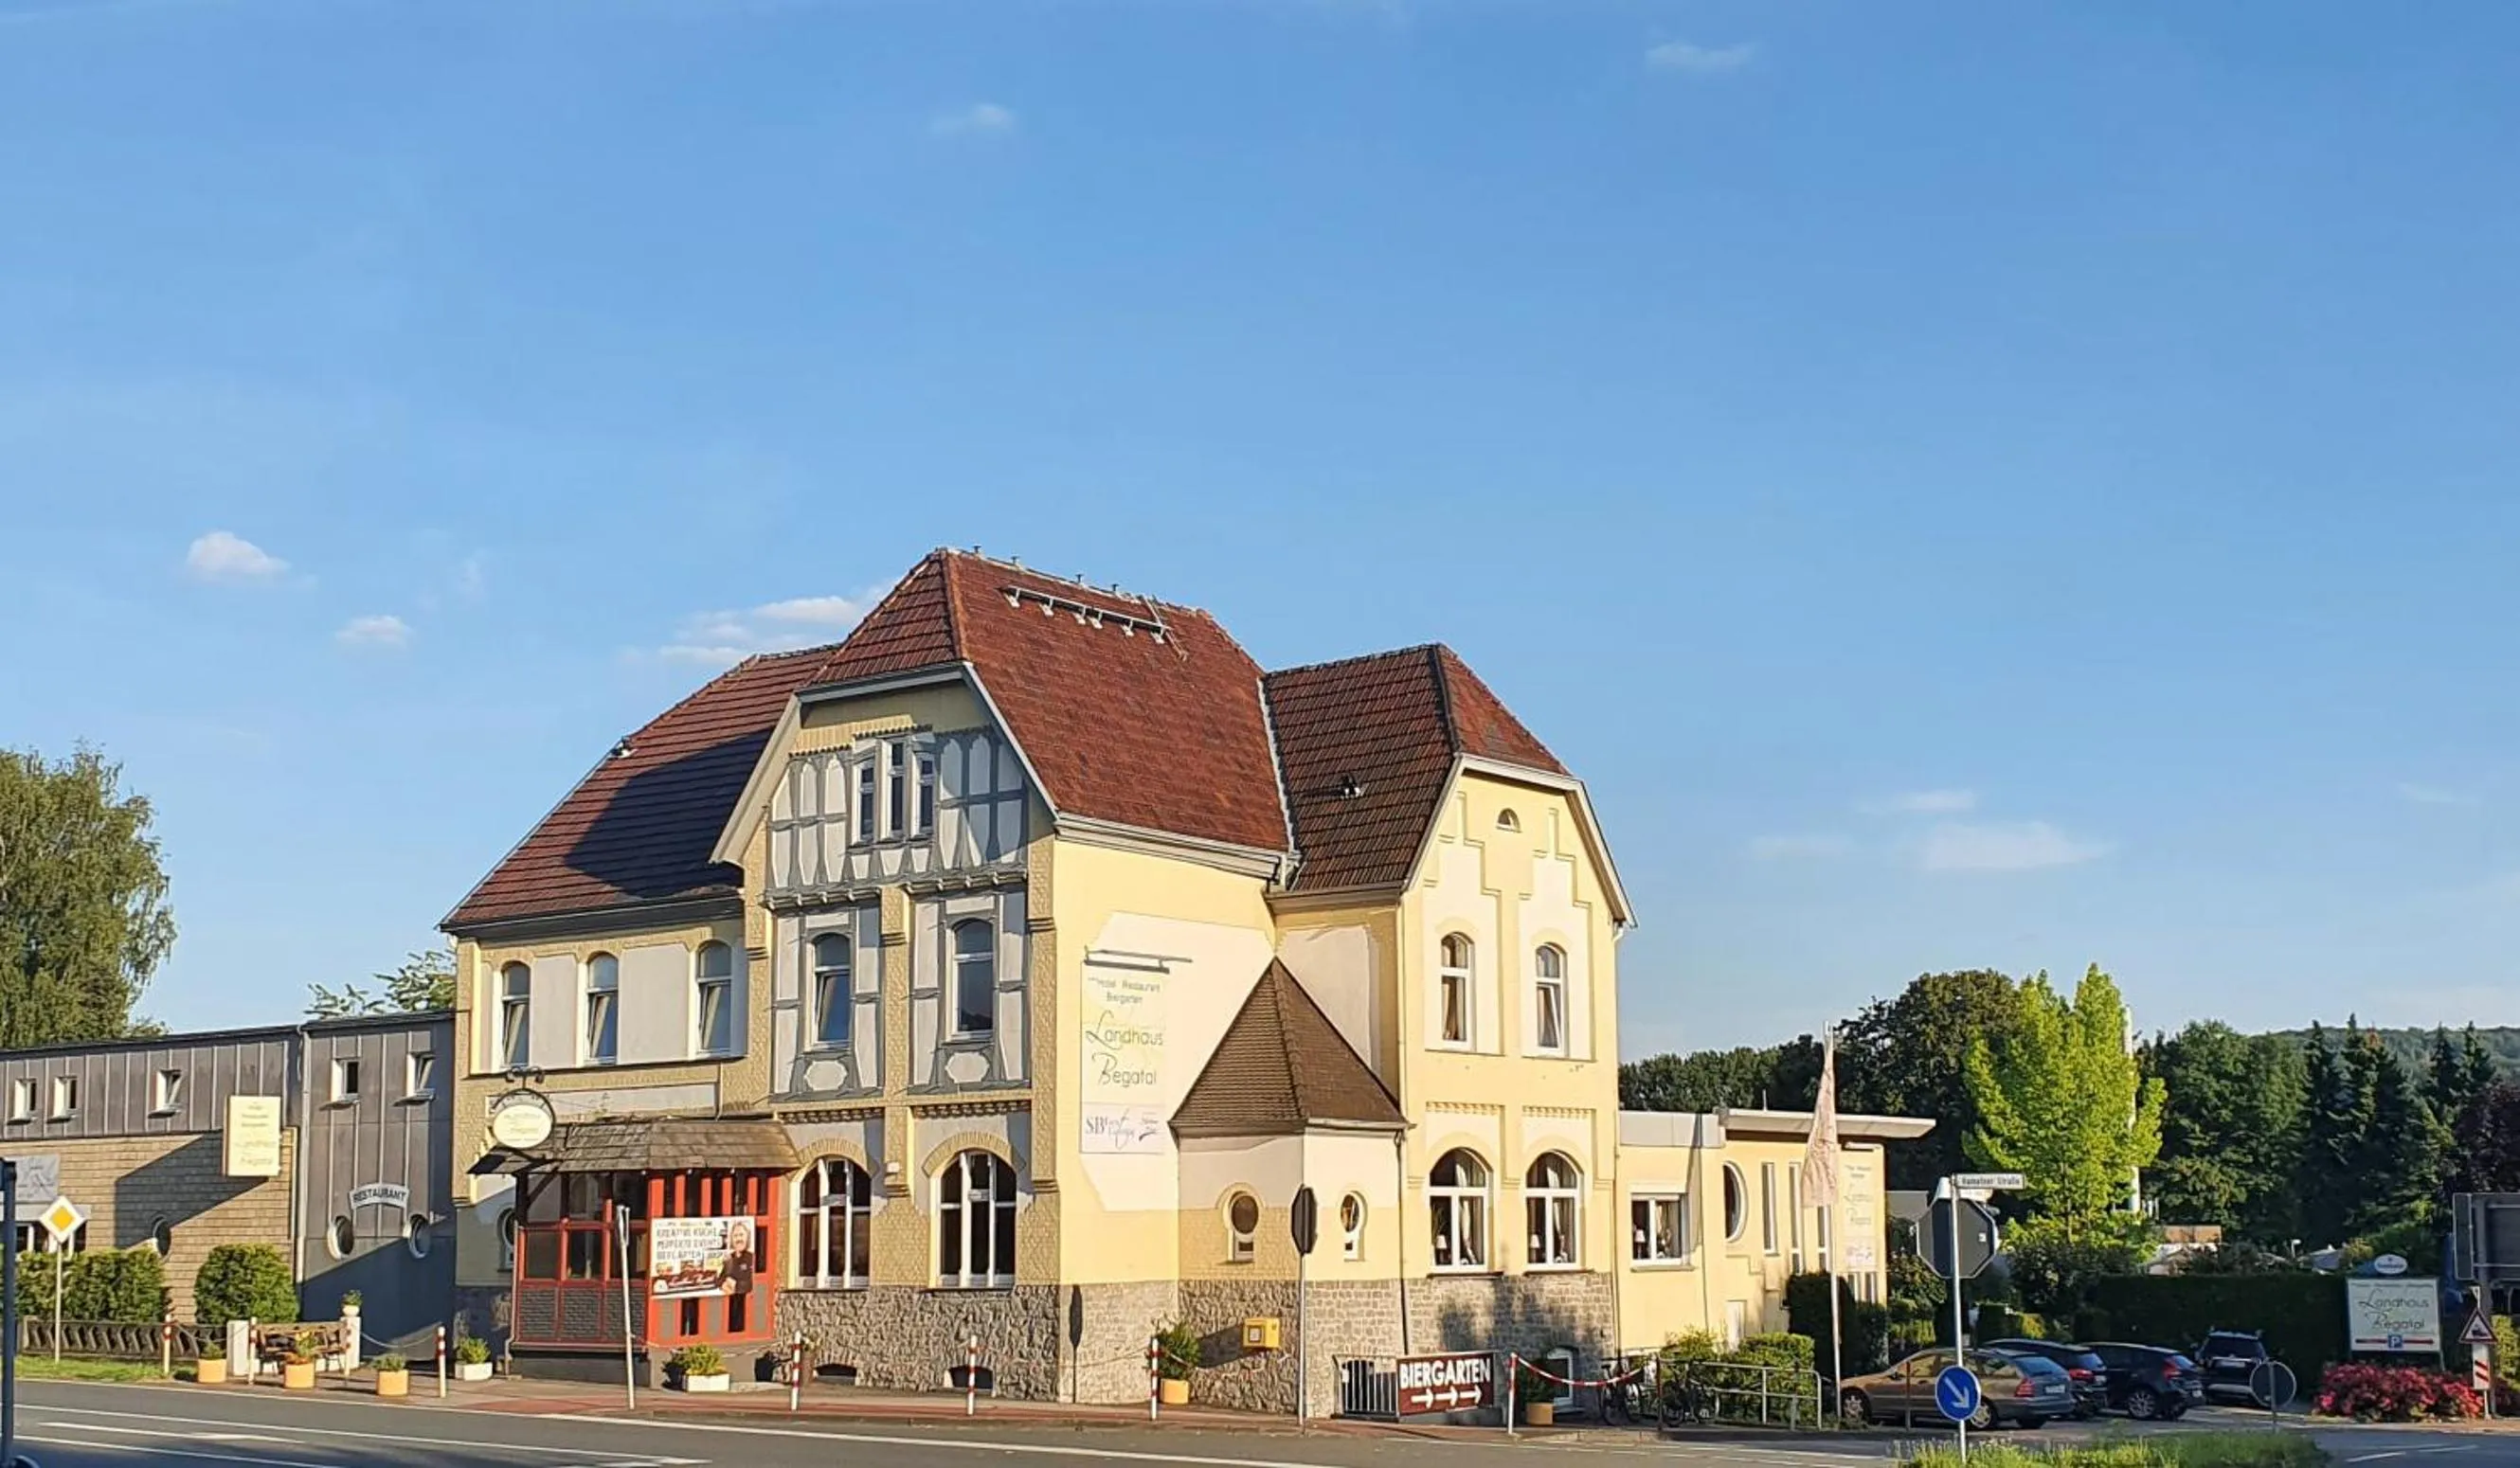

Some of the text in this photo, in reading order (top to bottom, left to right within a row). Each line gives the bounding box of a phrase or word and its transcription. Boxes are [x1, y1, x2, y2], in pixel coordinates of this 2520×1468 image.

[1086, 1010, 1163, 1050] Landhaus
[1091, 1052, 1157, 1088] Begatal
[353, 1188, 406, 1203] RESTAURANT
[2358, 1288, 2429, 1309] Landhaus
[1399, 1358, 1490, 1389] BIERGARTEN
